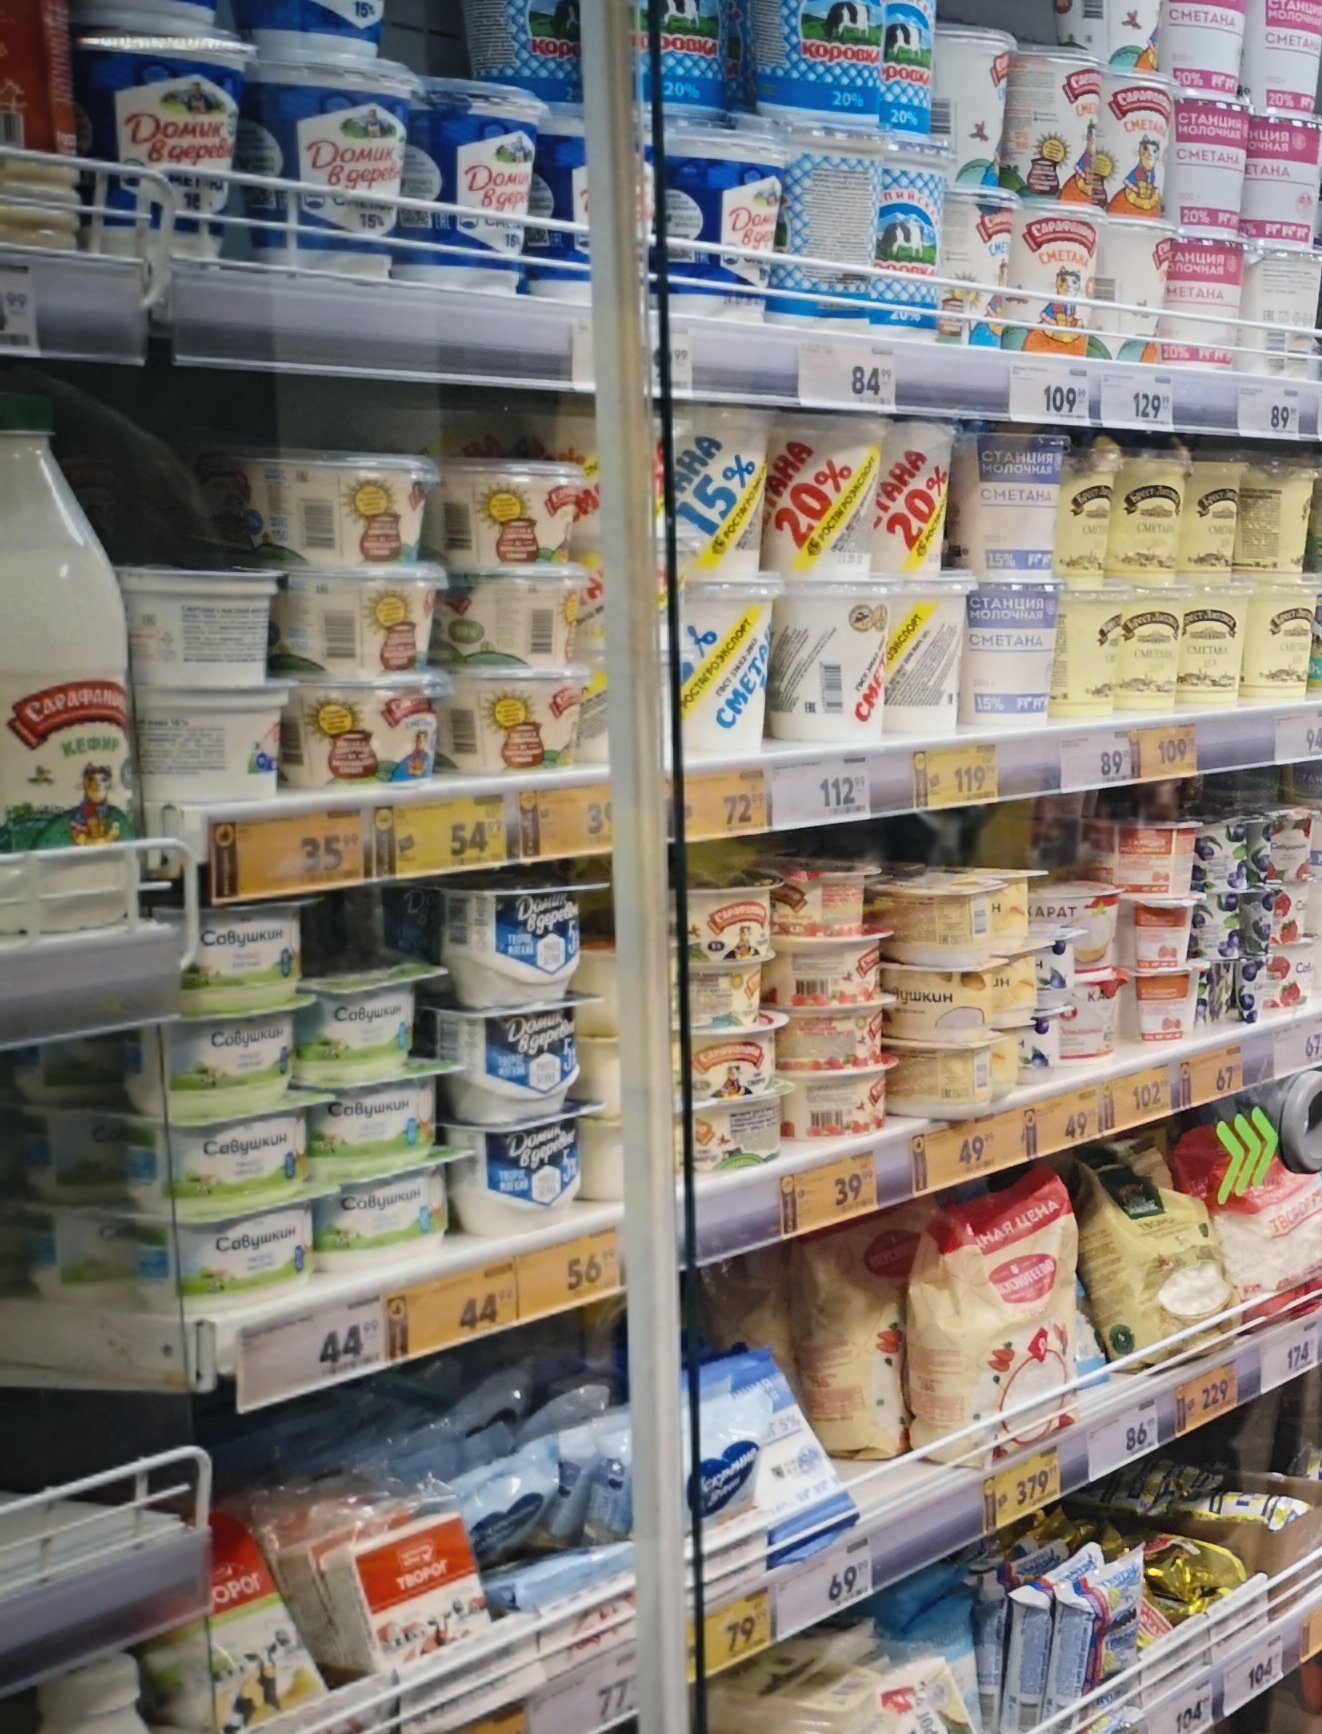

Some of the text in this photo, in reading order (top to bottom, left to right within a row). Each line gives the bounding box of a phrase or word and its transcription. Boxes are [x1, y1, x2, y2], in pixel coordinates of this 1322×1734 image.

[1169, 8, 1236, 27] СМЕТАНА
[1265, 32, 1320, 50] СМЕТАНА
[664, 81, 700, 99] 20%
[832, 91, 864, 108] 20%
[1267, 92, 1294, 107] 20%
[124, 112, 224, 144] Домик
[890, 109, 918, 126] 20%
[1178, 112, 1242, 129] СТАНЦИЯ
[1178, 123, 1241, 140] МОЛОЧНАЯ
[307, 140, 394, 170] Домик
[1177, 148, 1239, 165] СМЕТАНА
[1245, 162, 1290, 177] ЕТАНА
[1183, 210, 1209, 224] 20%
[1039, 250, 1088, 269] СМЕТАНА
[1167, 262, 1225, 275] ОЛОЧНАЯ
[1168, 250, 1225, 264] ТАНЦИЯ
[1167, 286, 1224, 300] МЕТАНА
[852, 366, 880, 396] 84
[1044, 386, 1076, 413] 109
[1133, 391, 1161, 418] 129
[1270, 406, 1290, 431] 89
[982, 449, 1054, 465] СТАНЦИЯ
[982, 462, 1053, 476] МОЛОЧНАЯ
[677, 454, 756, 537] 15%
[775, 459, 853, 550] 20%
[886, 465, 947, 551] 20%
[981, 488, 1052, 502] СМЕТАНА
[969, 596, 1045, 611] СТАНЦИЯ
[970, 609, 1044, 621] МОЛОЧНАЯ
[969, 633, 1044, 648] СМЕТАНА
[61, 736, 120, 758] КЕФИР
[1158, 740, 1188, 764] 109
[1100, 752, 1123, 777] 89
[954, 765, 985, 793] 119
[819, 777, 855, 808] 112
[723, 794, 751, 825] 72
[449, 820, 488, 856] 54
[301, 835, 343, 872] 35
[516, 893, 567, 921] Домик
[201, 928, 283, 948] Савушкин
[333, 1005, 402, 1024] Савушкин
[506, 1012, 563, 1042] Домик
[211, 1026, 284, 1049] Савушкин
[1216, 1068, 1233, 1091] 67
[327, 1097, 410, 1119] Савушкин
[1132, 1082, 1161, 1109] 102
[1064, 1113, 1087, 1139] 49
[203, 1131, 288, 1157] Савушкин
[508, 1128, 562, 1157] Домик
[958, 1136, 984, 1164] 49
[341, 1186, 421, 1211] Савушкин
[834, 1175, 862, 1206] 39
[1016, 1199, 1059, 1231] ЦЕНА
[216, 1224, 296, 1252] Савушкин
[567, 1259, 601, 1291] 56
[459, 1292, 497, 1330] 44
[319, 1323, 364, 1365] 44
[1201, 1379, 1229, 1407] 229
[1125, 1425, 1148, 1451] 86
[1016, 1475, 1048, 1506] 379
[395, 1560, 448, 1592] ТВОРОГ
[828, 1566, 857, 1601] 69
[726, 1616, 755, 1651] 79
[1247, 1659, 1274, 1688] 104
